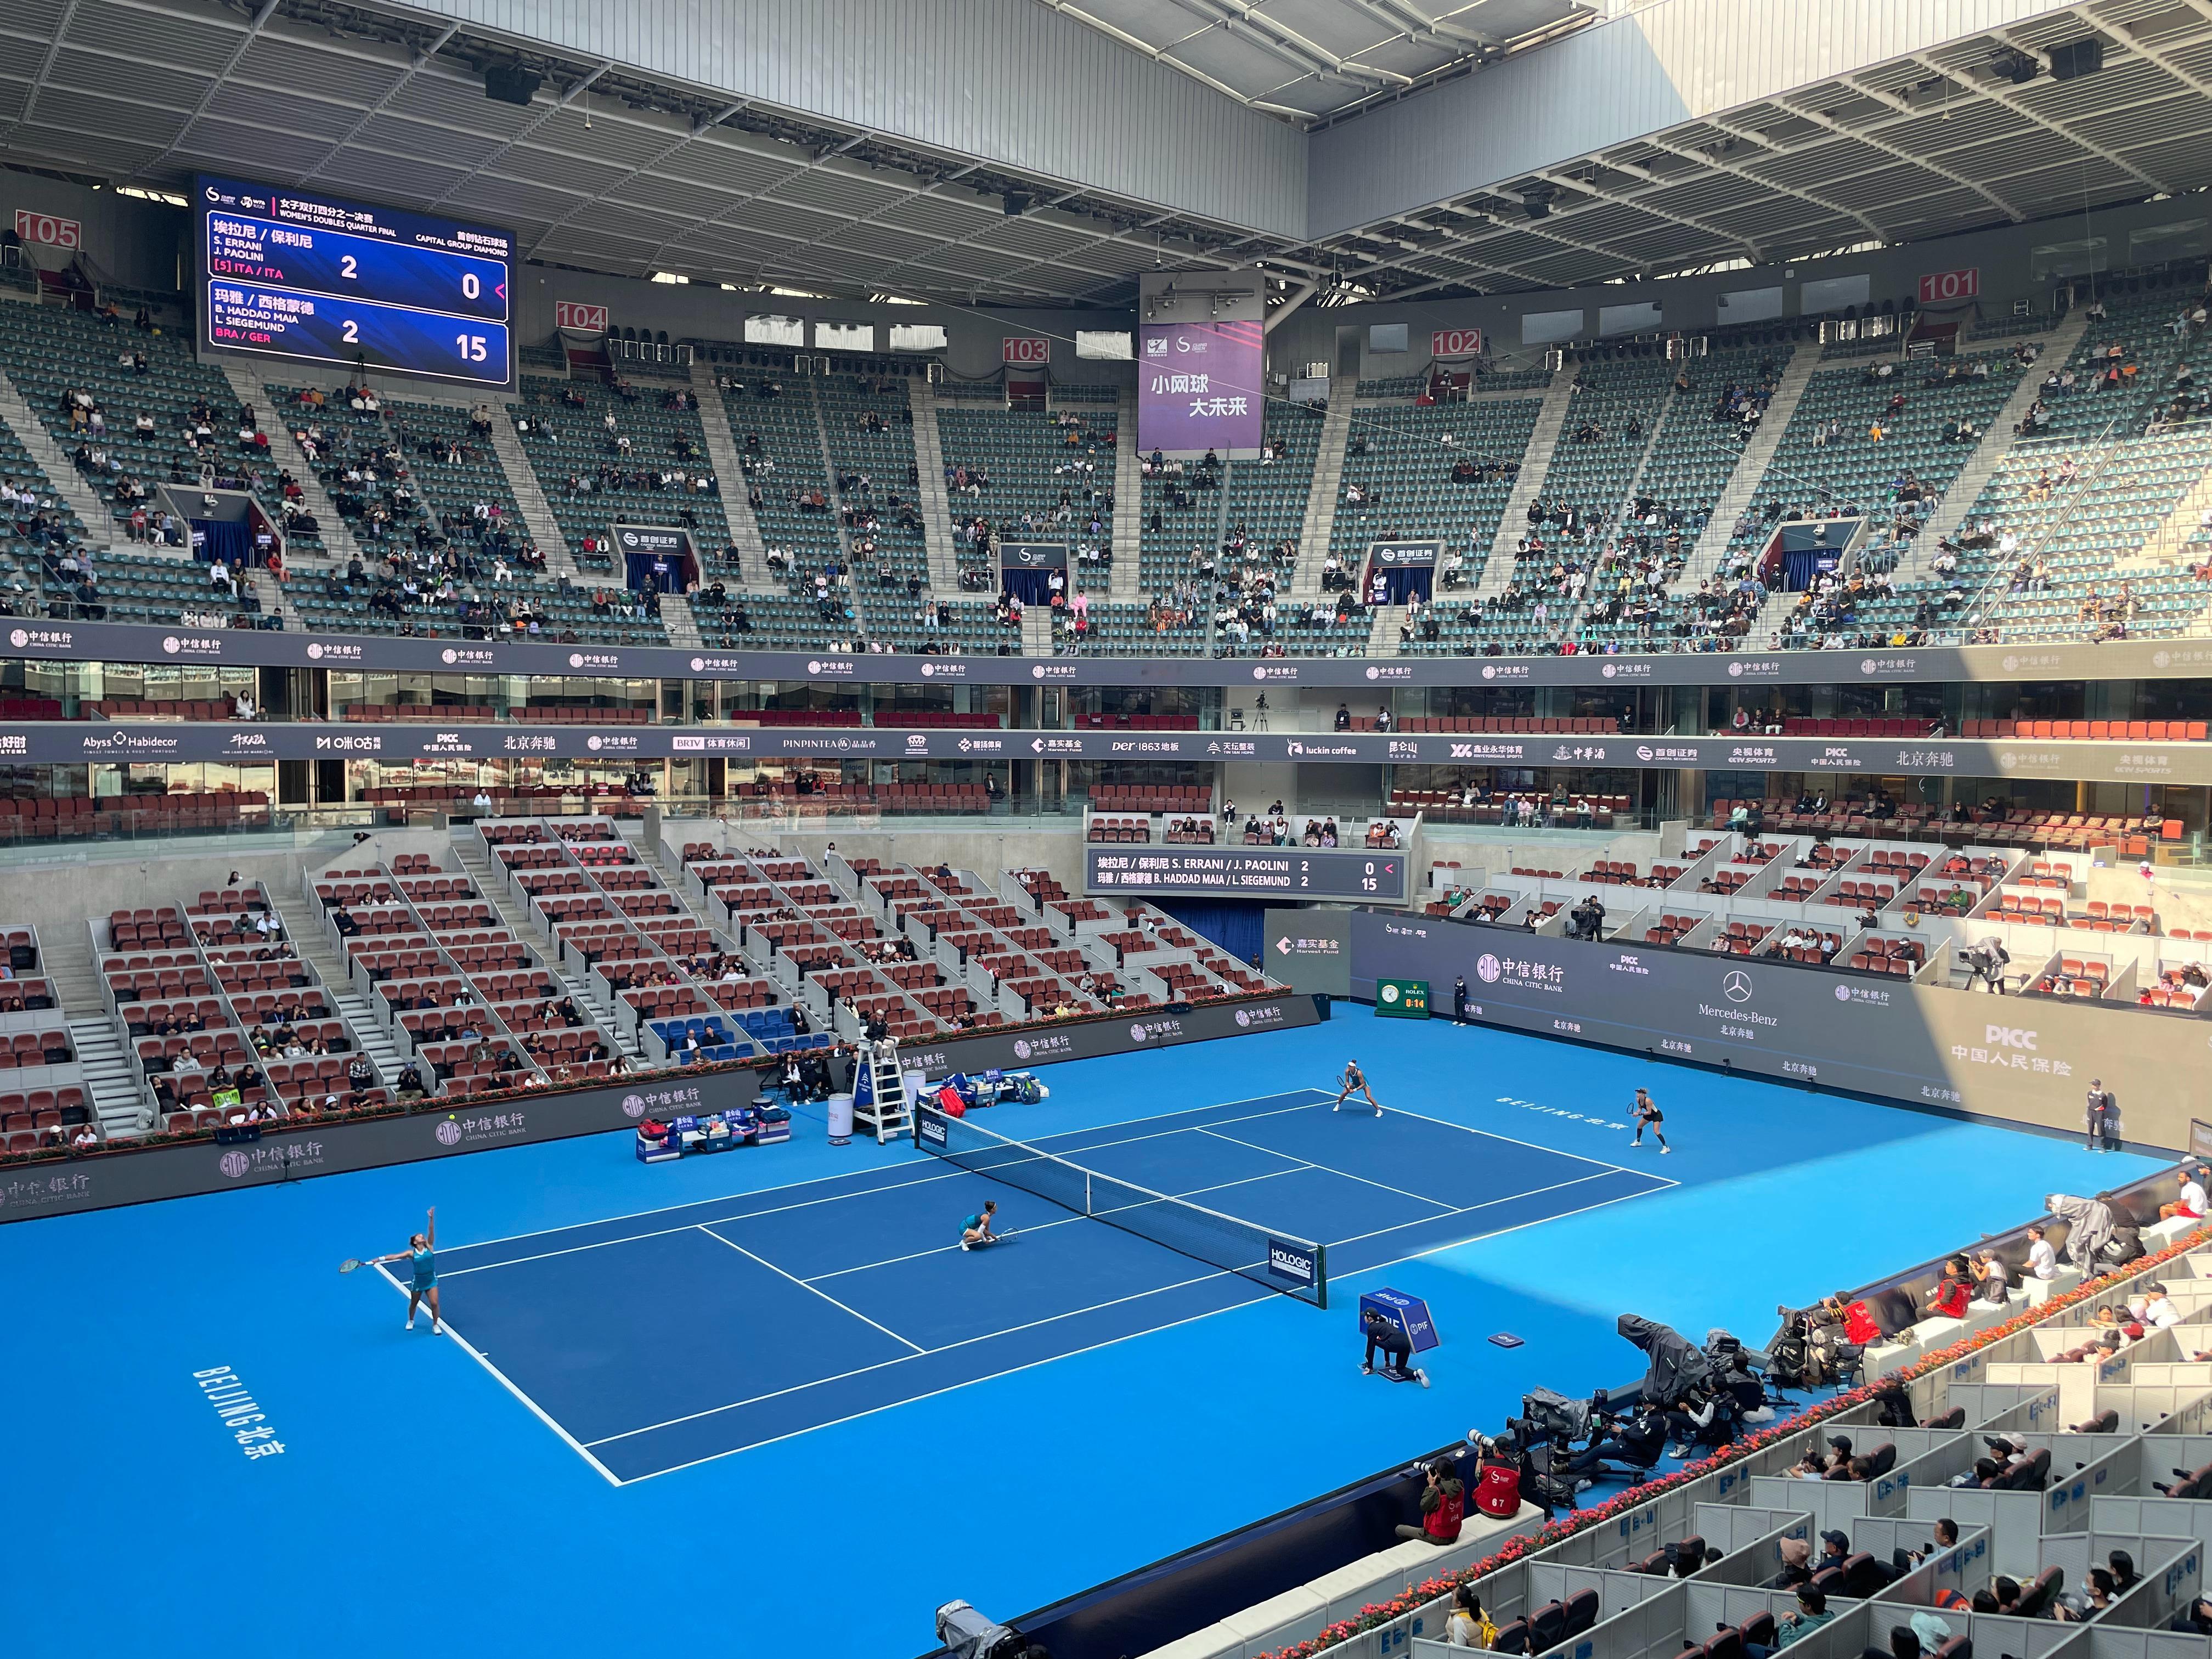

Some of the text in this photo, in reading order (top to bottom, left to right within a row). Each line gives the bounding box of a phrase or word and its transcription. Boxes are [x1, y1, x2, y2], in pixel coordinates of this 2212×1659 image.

[280, 199, 373, 224] 女子双打四分之一决赛
[19, 213, 78, 247] 105
[280, 210, 397, 237] WOMEN'S DOUBLES QUARTER FINAL
[213, 219, 313, 249] 埃拉尼 / 保利尼
[214, 236, 262, 251] S. ERRANI
[415, 234, 508, 257] CAPITAL GROUP DIAMOND
[214, 247, 263, 262] J. PAOLINI
[235, 263, 253, 274] ITA
[256, 267, 262, 276] /
[265, 268, 284, 279] ITA
[341, 255, 357, 279] 2
[462, 273, 479, 300] 0
[1924, 268, 1975, 298] 101
[215, 288, 314, 315] 玛雅 / 西格蒙德
[215, 304, 299, 324] B. HADDAD MAIA
[557, 305, 606, 329] 104
[226, 316, 285, 332] SIEGEMUND
[342, 320, 358, 343] 2
[216, 328, 271, 343] BRA / GER
[1434, 331, 1478, 353] 102
[456, 335, 487, 362] 15
[1005, 340, 1047, 361] 103
[1151, 374, 1209, 394] 小网球
[1189, 397, 1248, 417] 大未来
[705, 659, 737, 667] 中信银行
[822, 662, 853, 670] 中信银行
[1497, 666, 1529, 674] 中信银行
[1617, 664, 1651, 673] 中信银行
[1744, 662, 1780, 671] 中信银行
[1878, 659, 1915, 668] 中信银行
[0, 736, 26, 748] 好时
[83, 736, 177, 749] Abyss Habidecor
[437, 734, 458, 743] PICC
[504, 736, 555, 750] 北京奔驰
[603, 737, 637, 746] 中信银行
[707, 739, 746, 748] 体育休闲
[1389, 741, 1418, 754] 昆仑山
[1656, 749, 1697, 757] 首创证券
[1733, 748, 1773, 756] 央视体育
[1826, 748, 1847, 757] PICC
[1897, 751, 1953, 767] 北京奔驰
[1097, 857, 1288, 871] 埃拉尼 / 保利尼 S. ERRANI / J. PAOLINI
[1301, 861, 1308, 871] 2
[1365, 862, 1374, 874] 0
[1097, 872, 1290, 886] 玛雅 / 西格蒙德 B. HADDAD MAIA / L. SIEGEMUND
[1301, 876, 1308, 886] 2
[1362, 878, 1377, 890] 15
[1297, 939, 1339, 949] 嘉实基金
[1621, 955, 1638, 964] PICC
[1502, 958, 1564, 983] 中信银行
[1610, 963, 1649, 974] 中国人民保险
[1503, 978, 1523, 986] CHINA
[1544, 984, 1562, 992] BANK
[1851, 988, 1889, 1001] 中信银行
[1406, 998, 1424, 1008] 0:14
[1249, 1007, 1280, 1019] 中信银行
[1699, 1004, 1777, 1026] Mercedes-Benz
[1145, 1020, 1180, 1033] 中信银行
[1554, 1019, 1581, 1032] 北京奔驰
[1720, 1025, 1753, 1040] 北京奔驰
[1030, 1036, 1069, 1049] 中信银行
[1986, 1024, 2037, 1049] PICC
[1661, 1039, 1691, 1053] 北京奔驰
[902, 1053, 945, 1068] 中信银行
[1953, 1045, 2072, 1076] 中国人民保险
[1782, 1061, 1816, 1076] 北京奔驰
[646, 1088, 699, 1106] 中信银行
[1921, 1086, 1960, 1102] 北京奔驰
[1495, 1097, 1584, 1119] BEIJING
[462, 1113, 524, 1133] 中信银行
[922, 1119, 945, 1135] HOLOGIC
[1583, 1118, 1629, 1130] 北京
[252, 1141, 323, 1164] 中信银行
[1375, 1293, 1397, 1301] PIF
[1417, 1321, 1427, 1332] PIF
[193, 1365, 266, 1427] BEIJING
[234, 1426, 286, 1460] 北京
